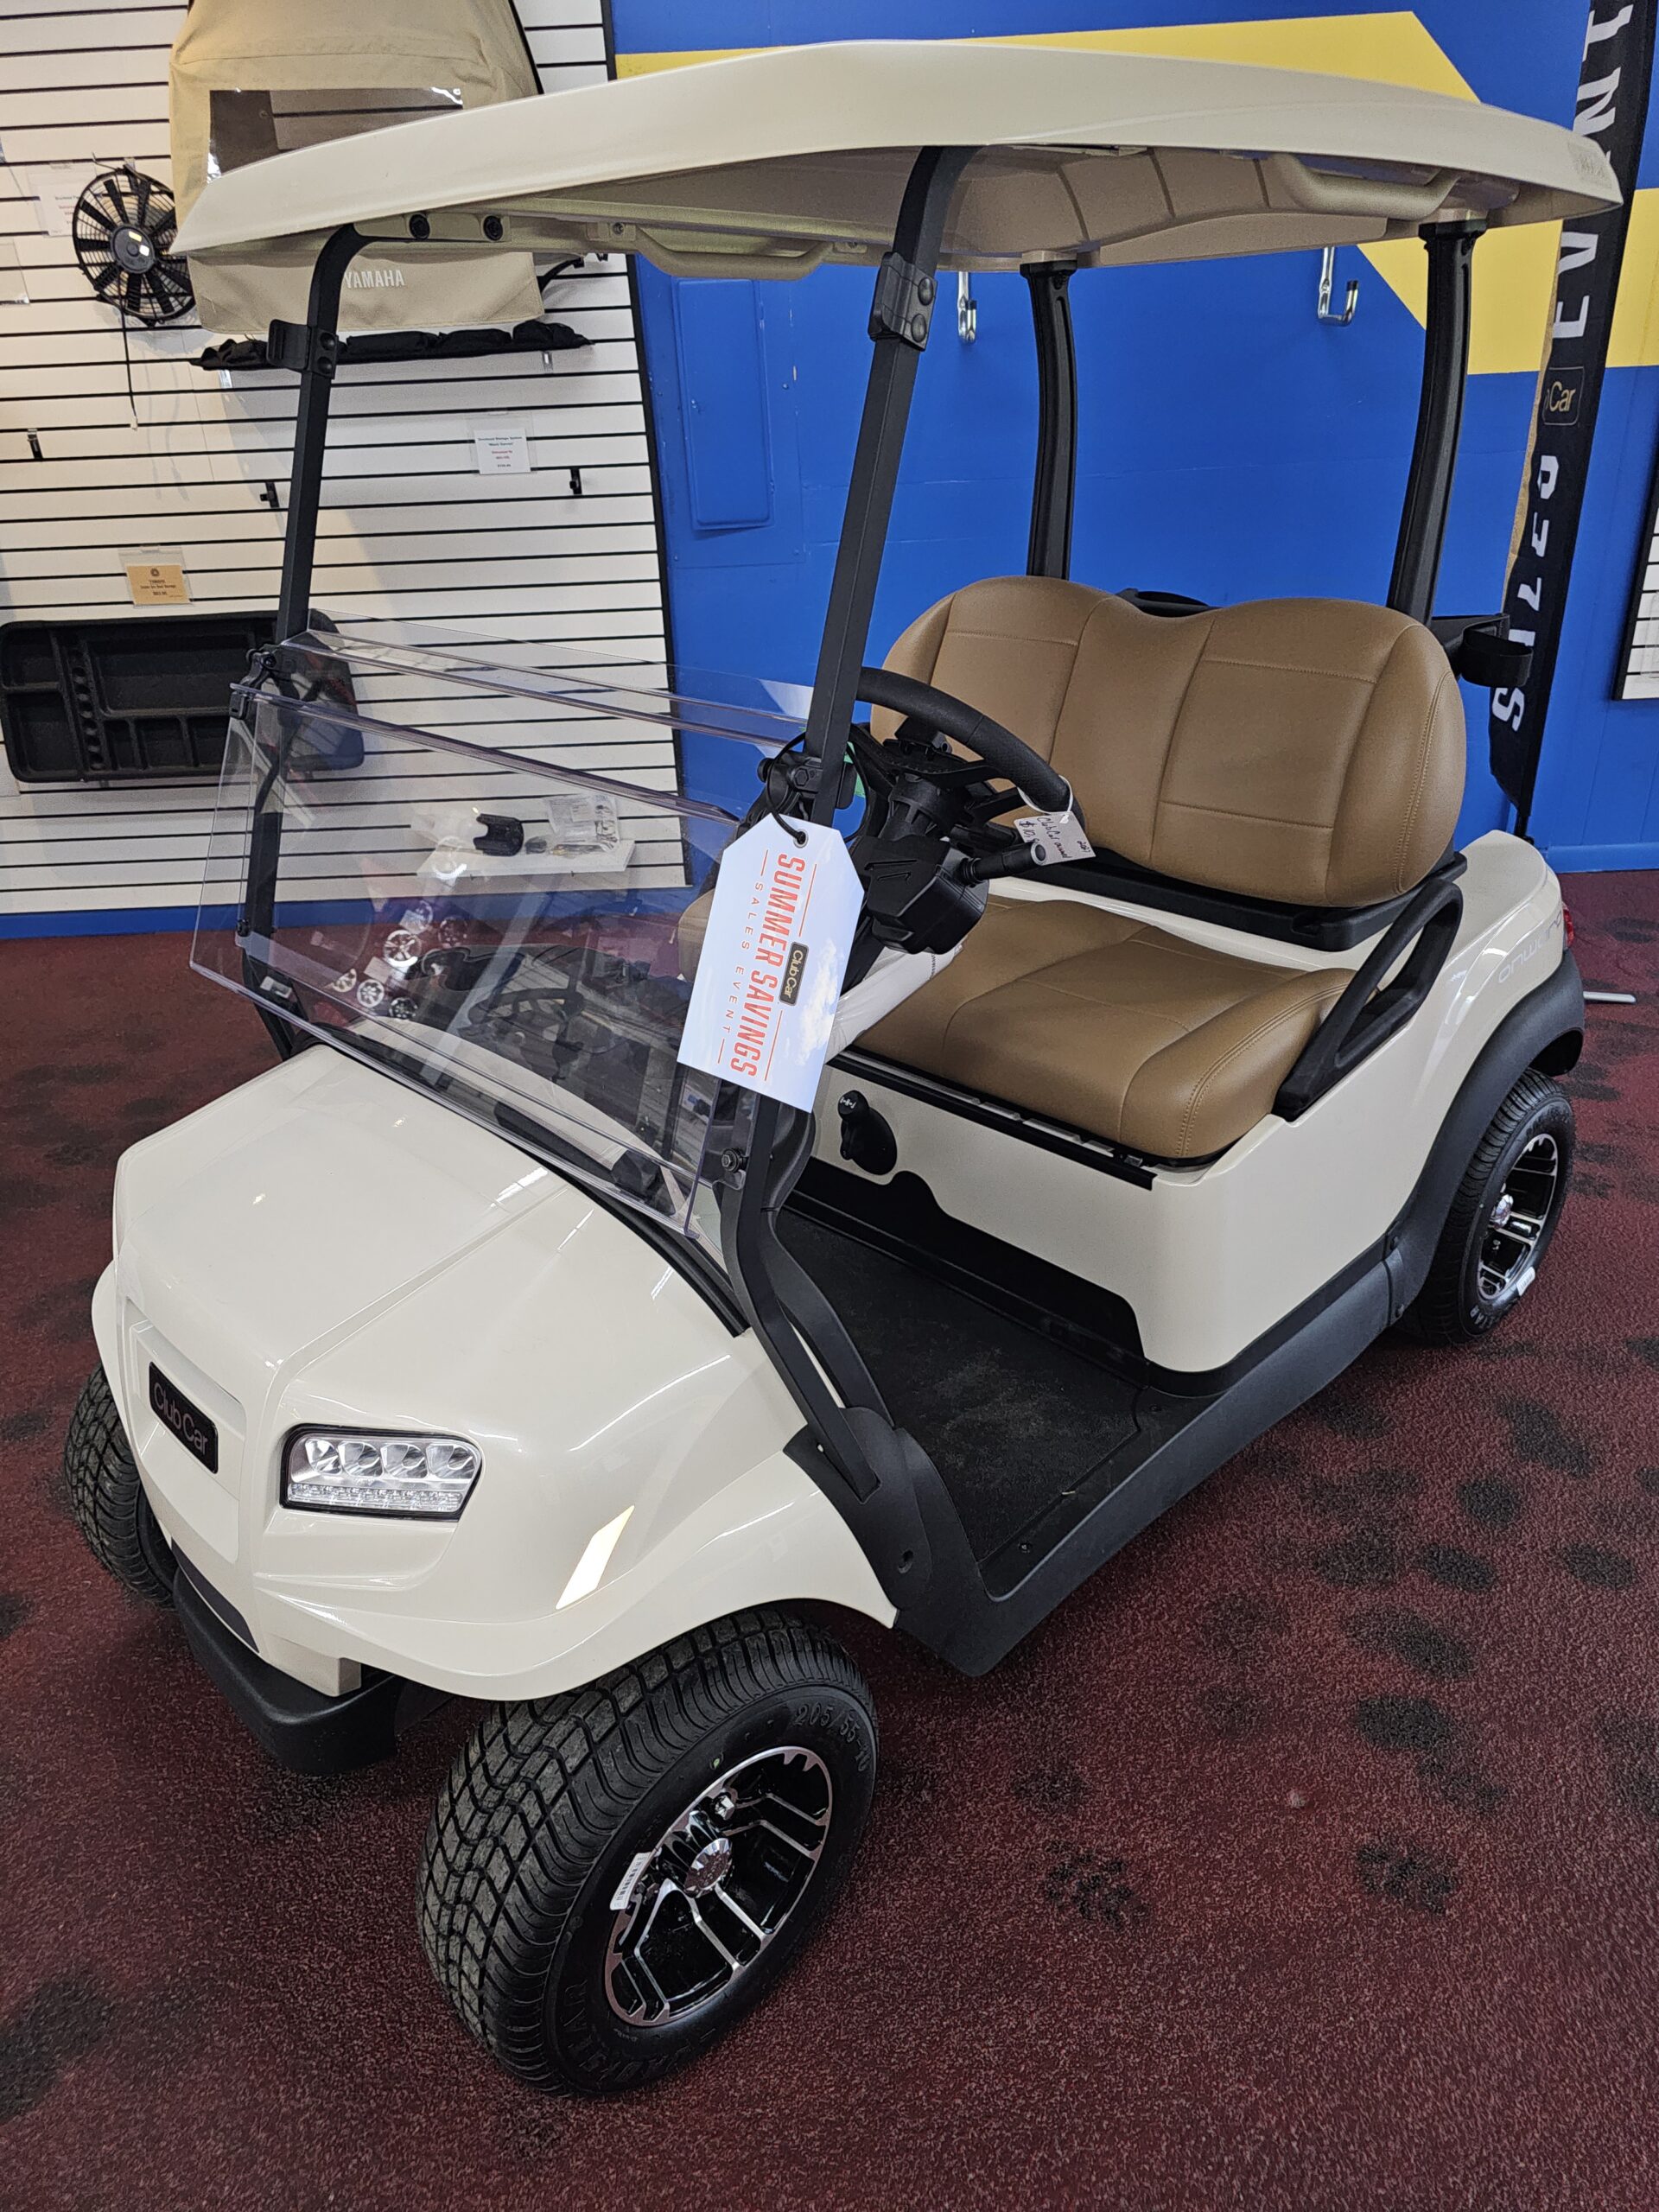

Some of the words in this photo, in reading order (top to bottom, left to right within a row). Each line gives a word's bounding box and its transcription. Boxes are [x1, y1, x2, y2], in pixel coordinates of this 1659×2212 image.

[345, 269, 405, 289] YAMAHA
[1549, 381, 1576, 412] Car
[741, 881, 764, 950] SALES
[753, 852, 805, 968] SUMMER
[784, 976, 797, 998] Car
[789, 950, 804, 976] Club
[721, 965, 745, 1033] EVENT
[730, 969, 779, 1077] SAVINGS
[153, 1382, 181, 1430] Club
[182, 1413, 208, 1456] Car
